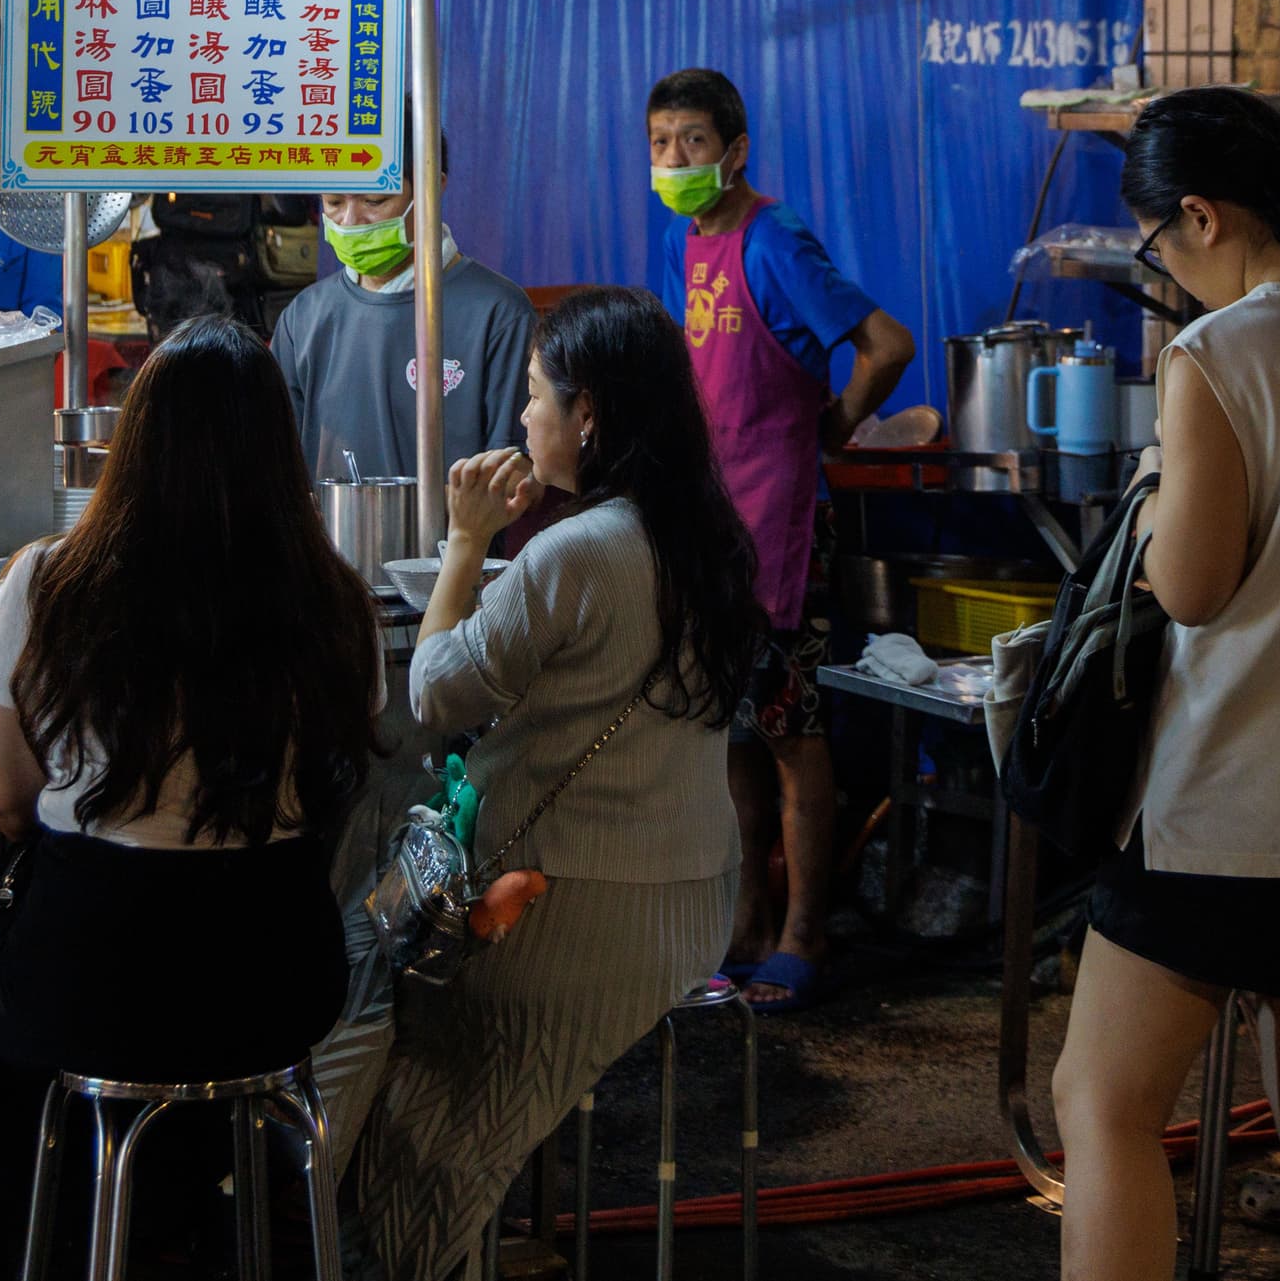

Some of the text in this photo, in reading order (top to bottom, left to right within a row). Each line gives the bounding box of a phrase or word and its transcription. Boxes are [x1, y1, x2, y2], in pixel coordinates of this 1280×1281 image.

[73, 110, 116, 134] 90
[129, 111, 173, 135] 105
[186, 111, 230, 136] 110
[243, 111, 284, 136] 95
[296, 113, 339, 137] 125
[37, 144, 342, 166] 元宵盒裝請至店內購買
